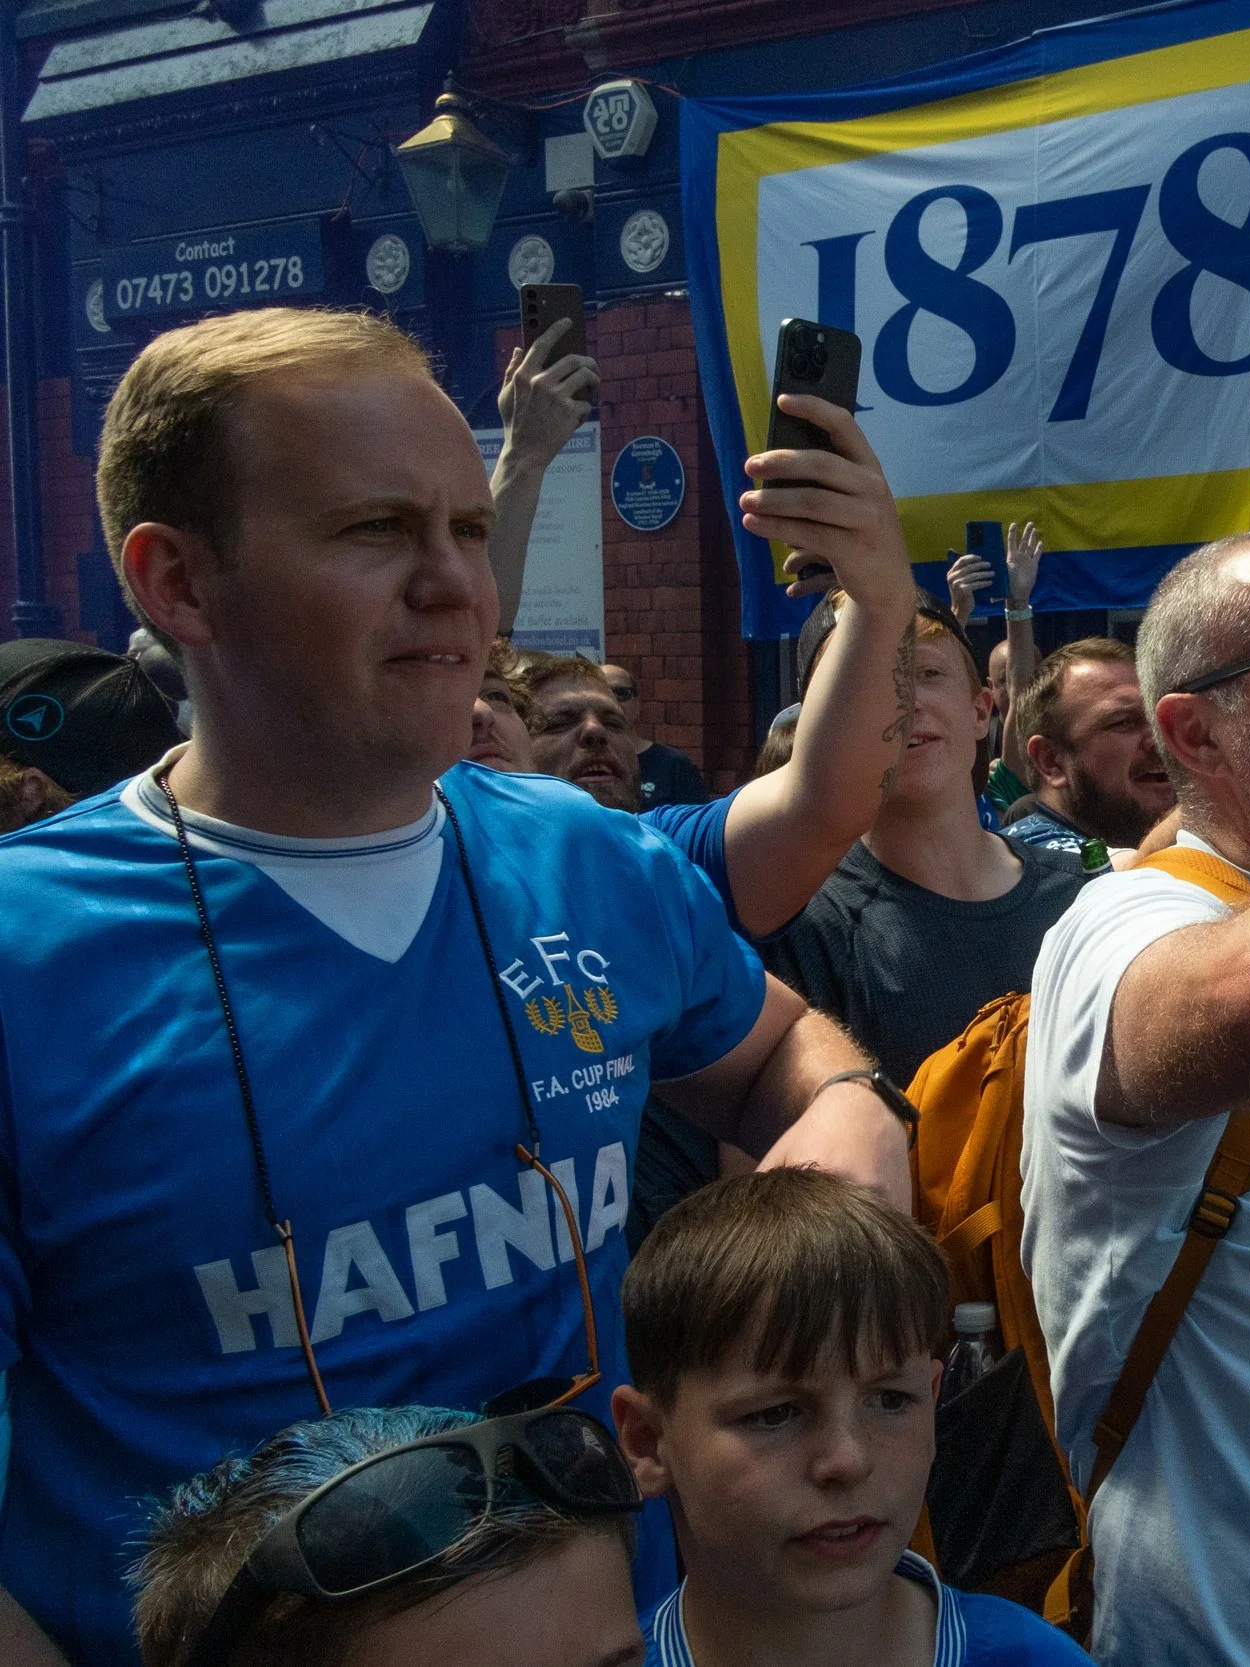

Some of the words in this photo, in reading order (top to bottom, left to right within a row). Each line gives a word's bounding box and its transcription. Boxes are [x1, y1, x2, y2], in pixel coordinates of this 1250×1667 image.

[175, 236, 236, 262] Contact
[116, 270, 194, 310] 07473
[204, 255, 304, 298] 091278
[498, 931, 611, 1000] EFC
[531, 1075, 570, 1103] F.A.
[571, 1063, 604, 1090] CUP
[606, 1053, 636, 1081] FINAL
[585, 1085, 620, 1114] 1984
[193, 1140, 629, 1354] HAFNIA
